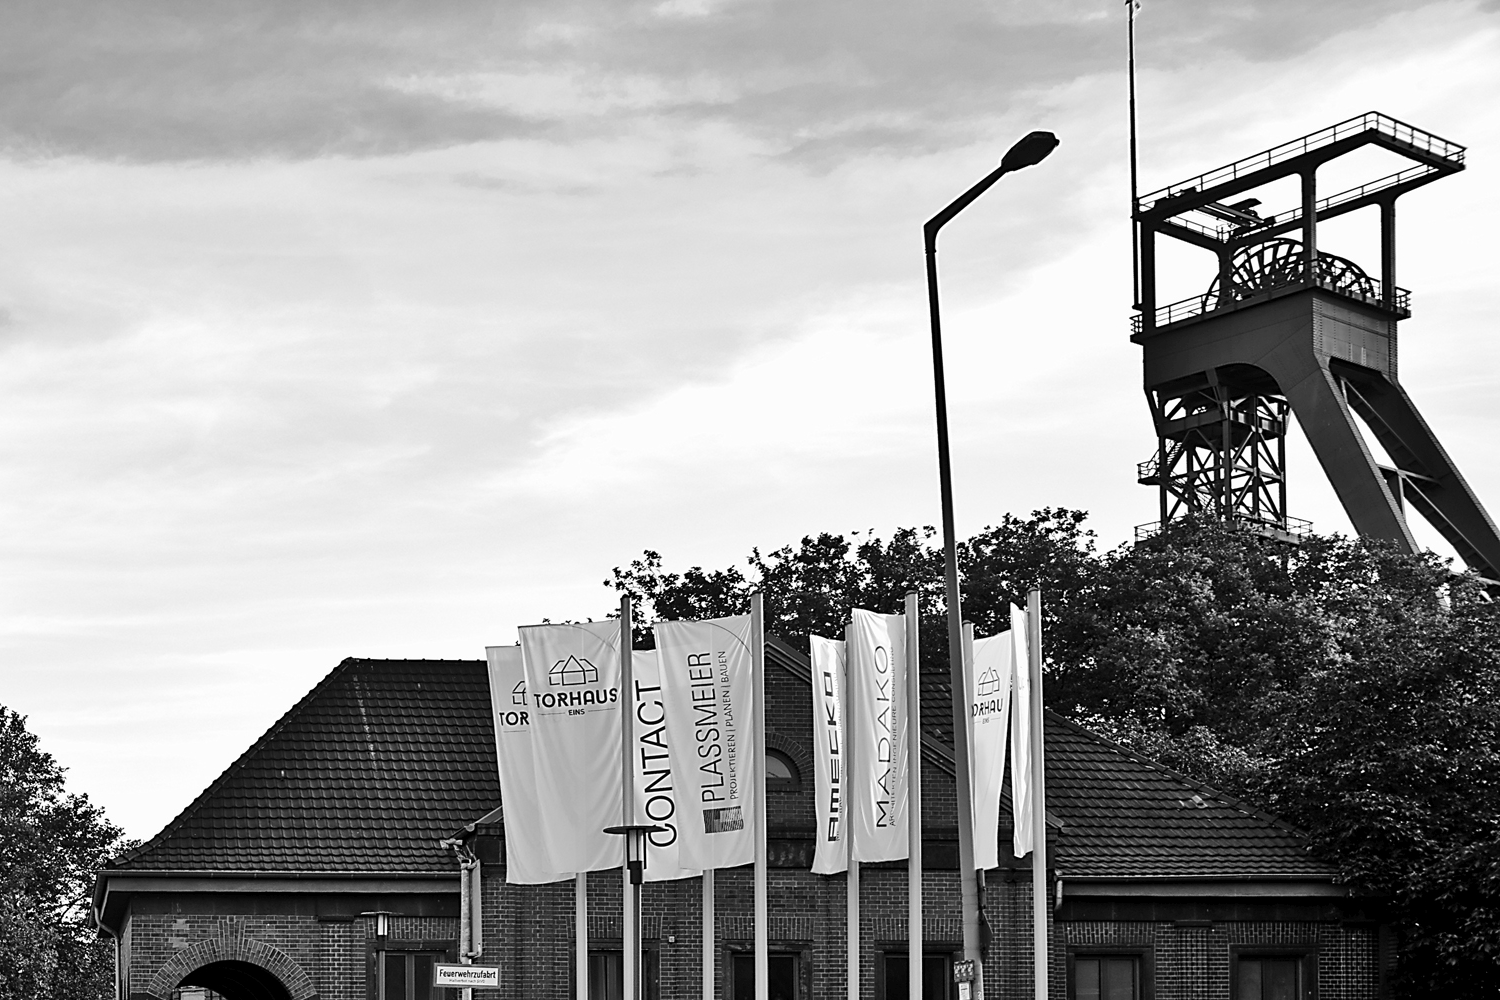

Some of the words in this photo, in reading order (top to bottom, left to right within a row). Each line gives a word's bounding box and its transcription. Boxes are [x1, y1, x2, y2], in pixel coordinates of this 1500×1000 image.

[718, 651, 729, 683] BAUEN
[533, 688, 618, 708] TORHAUS
[568, 708, 585, 716] EINS
[723, 691, 734, 727] PLANEN
[499, 711, 529, 726] TOR
[687, 652, 725, 803] PLASSMEIER
[874, 646, 891, 828] MADAKO
[635, 680, 677, 847] CONTACT
[727, 734, 739, 800] PROJEKTIEREN
[439, 969, 496, 979] Feuerwehrzufahrt
